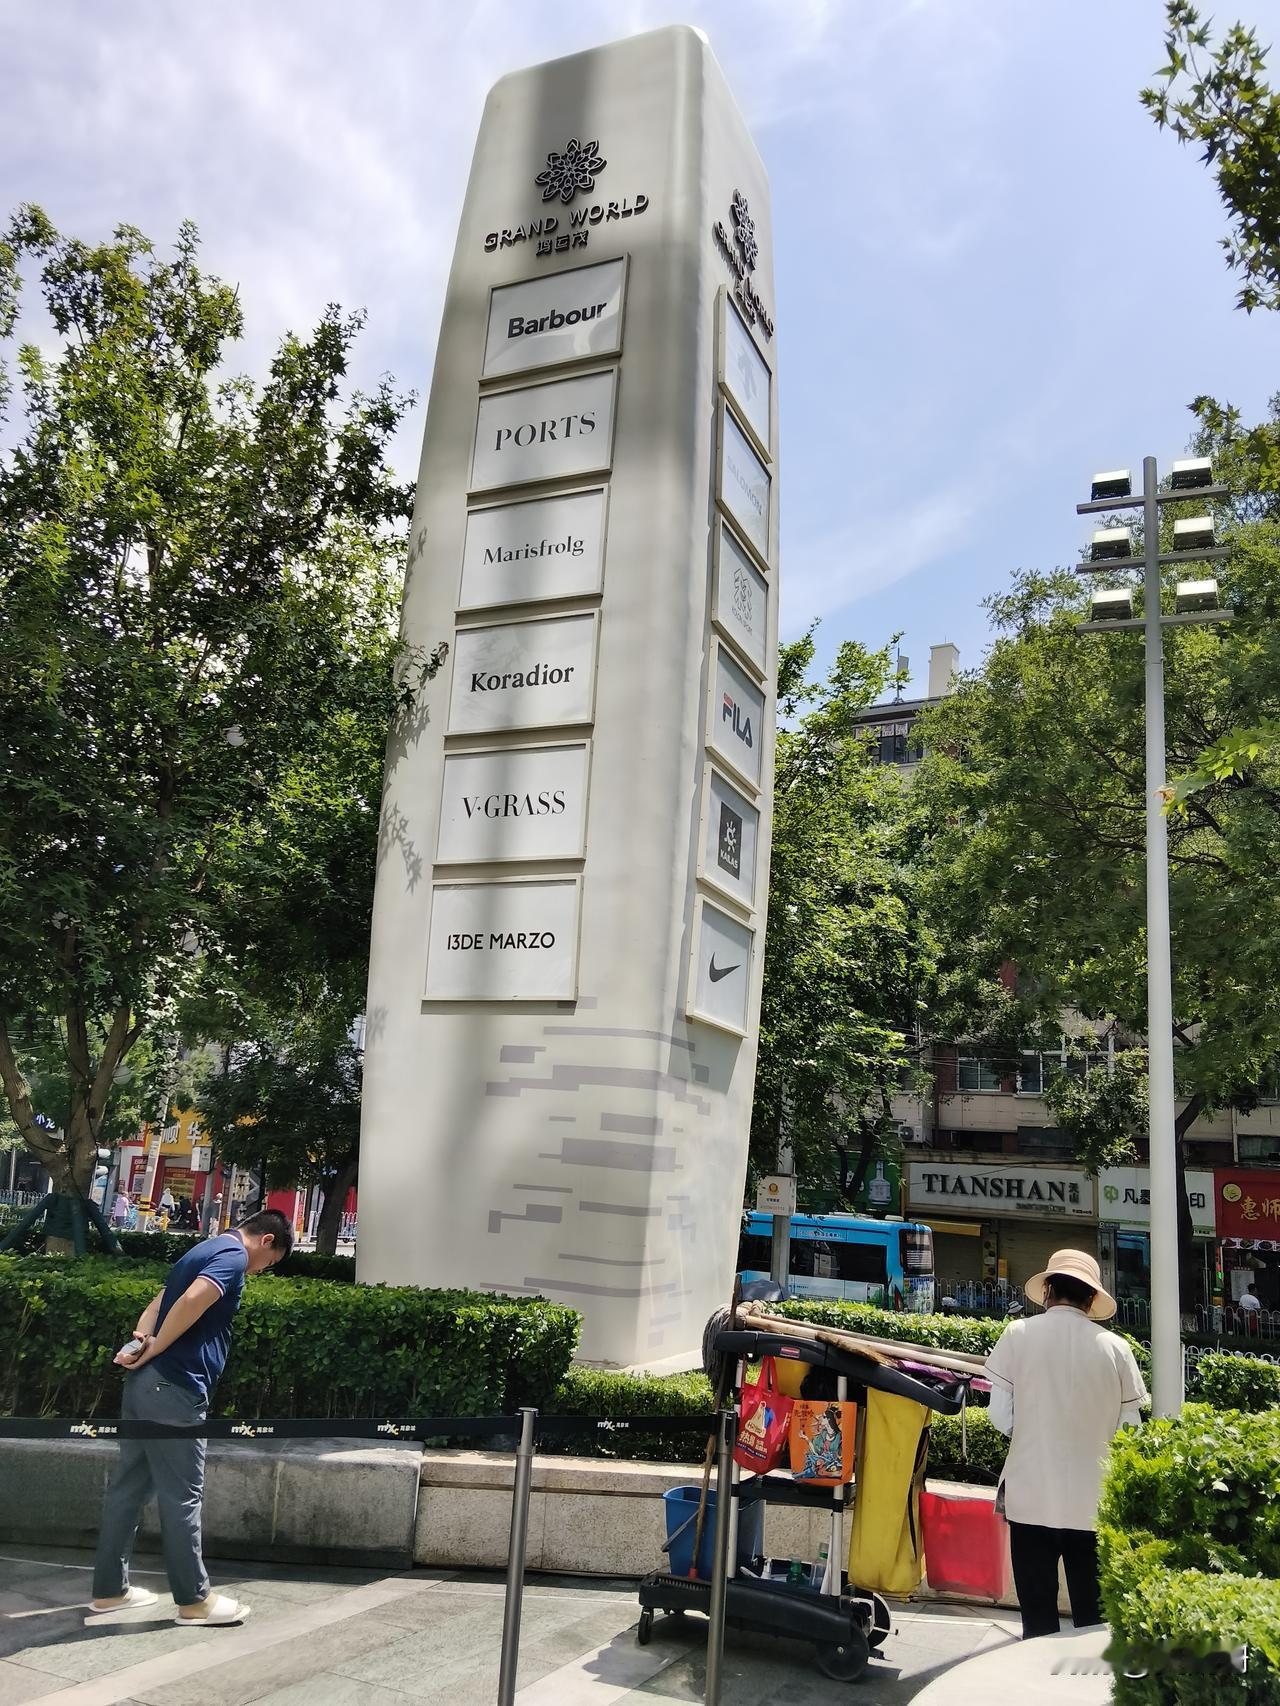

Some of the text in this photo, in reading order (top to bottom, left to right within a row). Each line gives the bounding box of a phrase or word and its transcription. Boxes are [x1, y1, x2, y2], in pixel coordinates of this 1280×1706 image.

[484, 194, 649, 253] GRAND WORLD
[507, 301, 607, 339] Barbour
[494, 411, 597, 451] PORTS
[483, 535, 585, 566] Marisfrolg
[470, 664, 575, 693] Koradior
[722, 692, 753, 749] FILA
[489, 931, 556, 950] MARZO
[922, 1173, 1066, 1202] TIANSHAN
